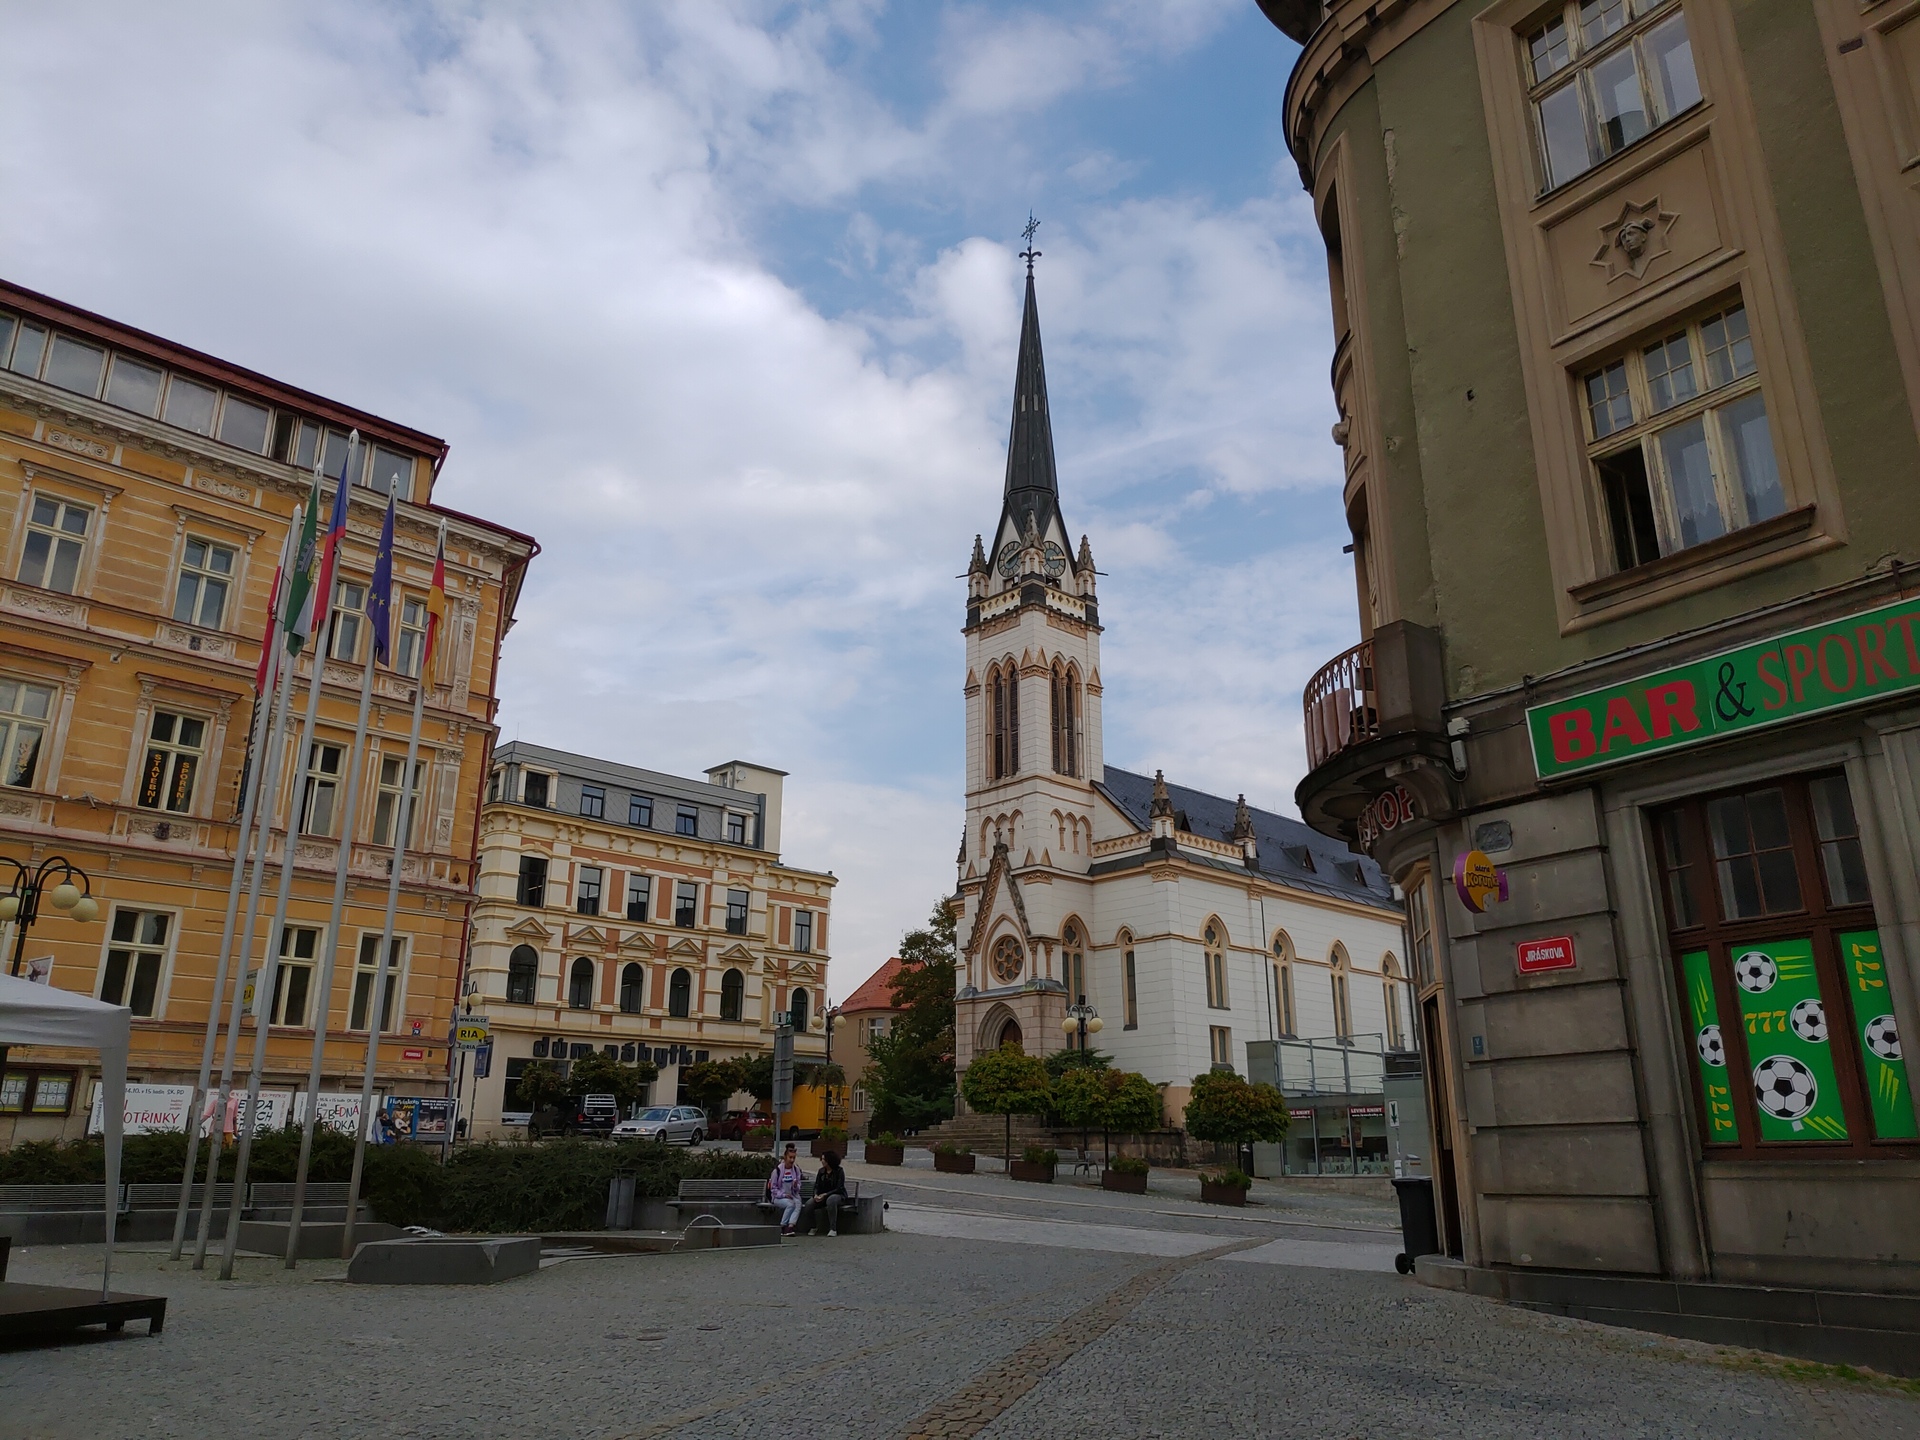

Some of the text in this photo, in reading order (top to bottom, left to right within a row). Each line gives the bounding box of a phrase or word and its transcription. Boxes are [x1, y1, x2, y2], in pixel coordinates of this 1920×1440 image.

[1548, 679, 1703, 765] BAR
[1714, 661, 1755, 722] &
[1525, 946, 1565, 962] JIRÁSKOVA
[1744, 1009, 1787, 1035] 777
[460, 1029, 479, 1039] RIA
[533, 1036, 594, 1060] dům
[123, 1110, 181, 1124] OTŘINKY
